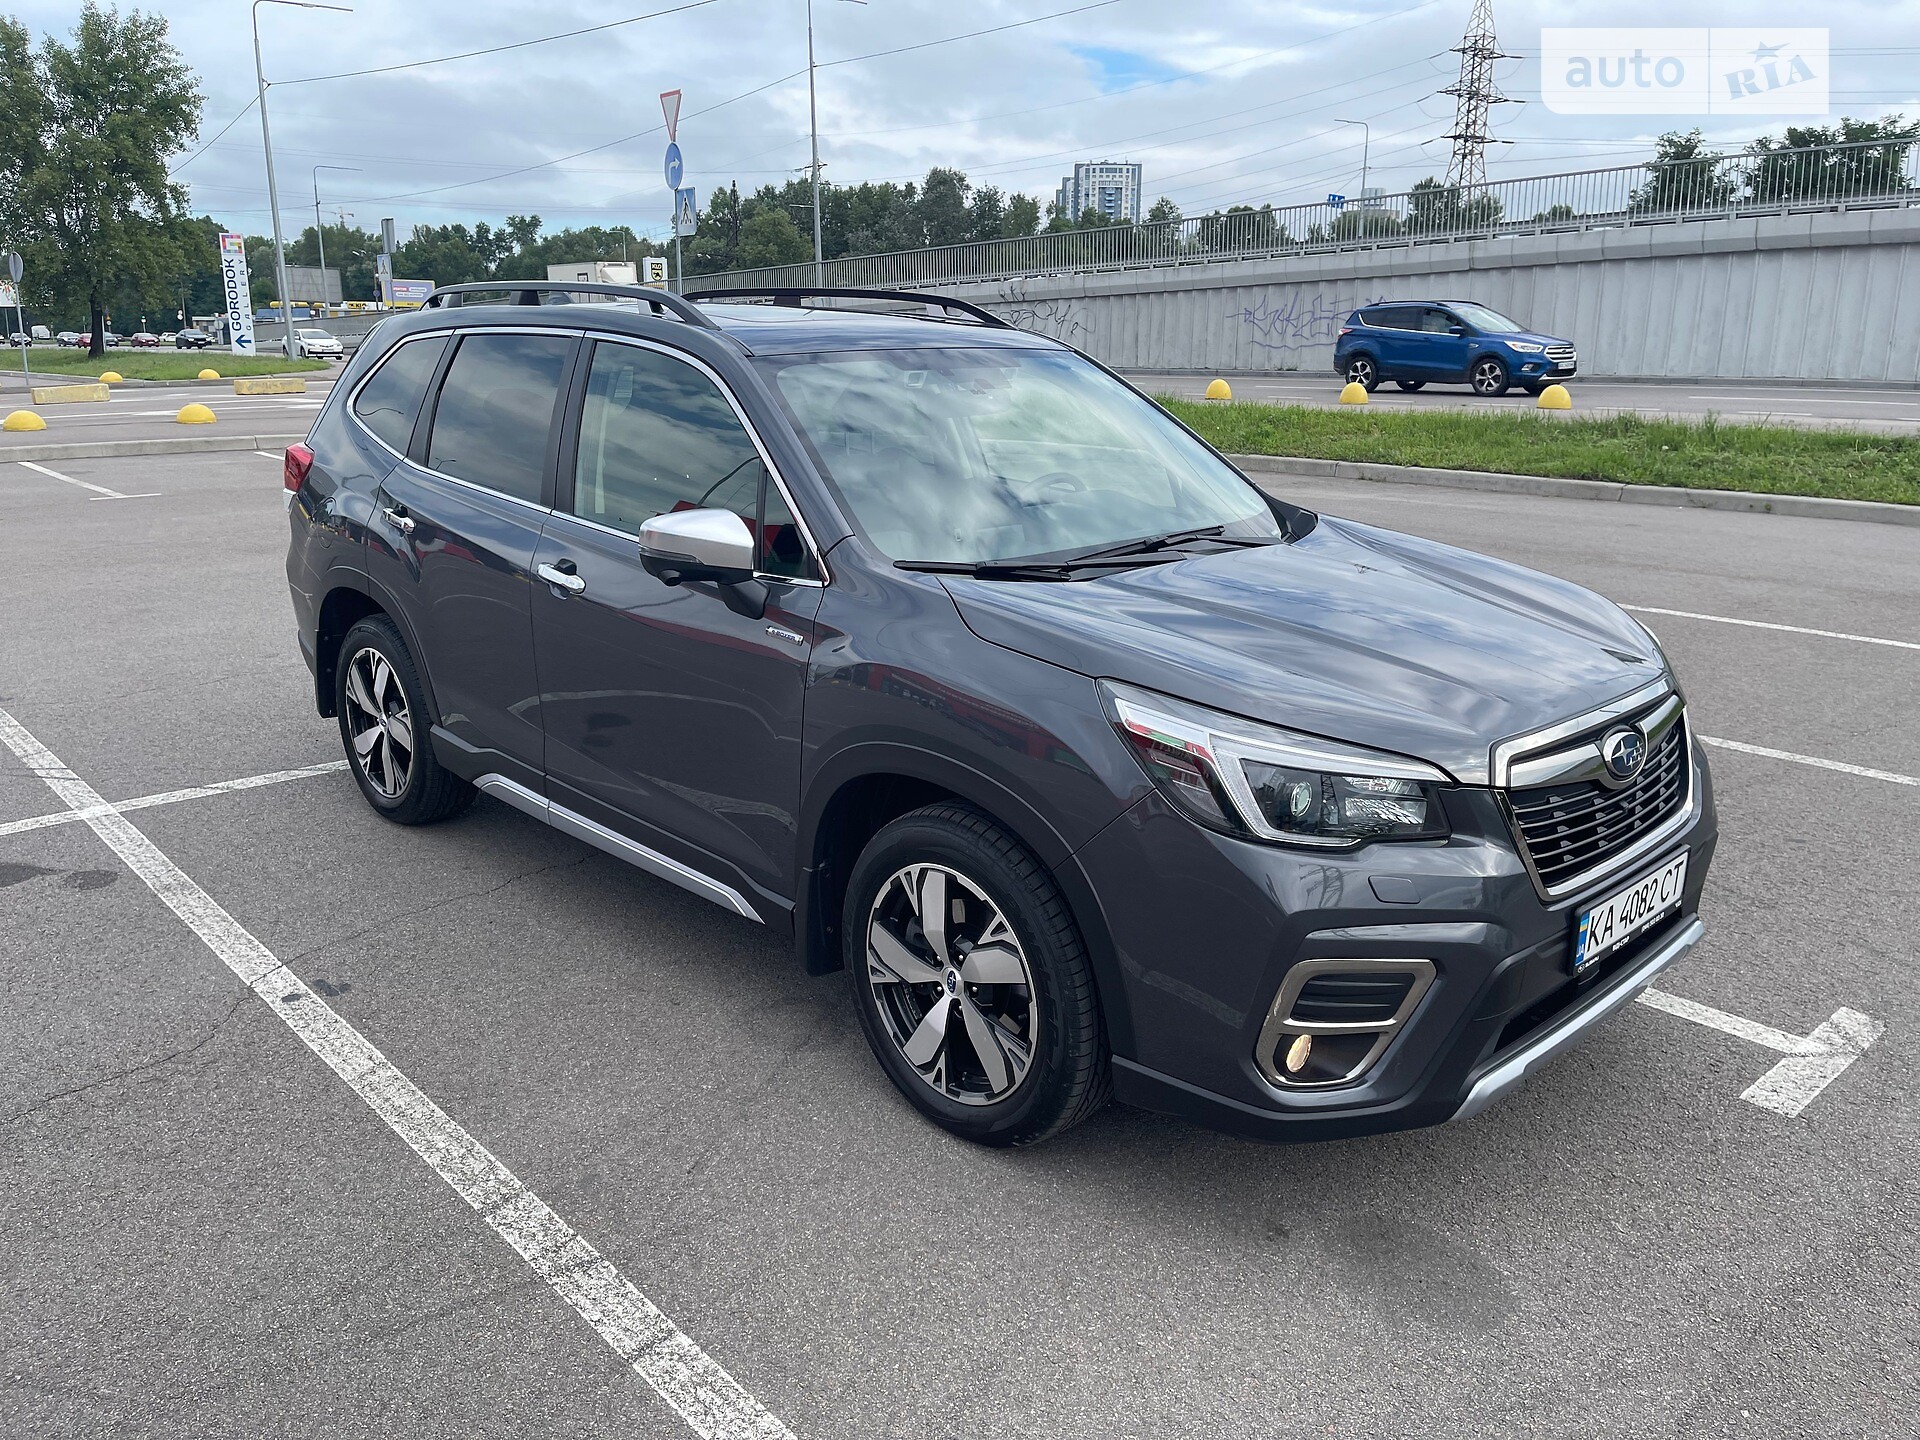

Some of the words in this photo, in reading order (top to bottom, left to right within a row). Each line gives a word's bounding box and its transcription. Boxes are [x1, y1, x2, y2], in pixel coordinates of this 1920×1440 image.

[224, 258, 242, 331] GORODOK
[239, 259, 252, 331] GALLERY
[1587, 904, 1614, 953] KA
[1619, 877, 1659, 930] 4082
[1660, 860, 1685, 903] CT
